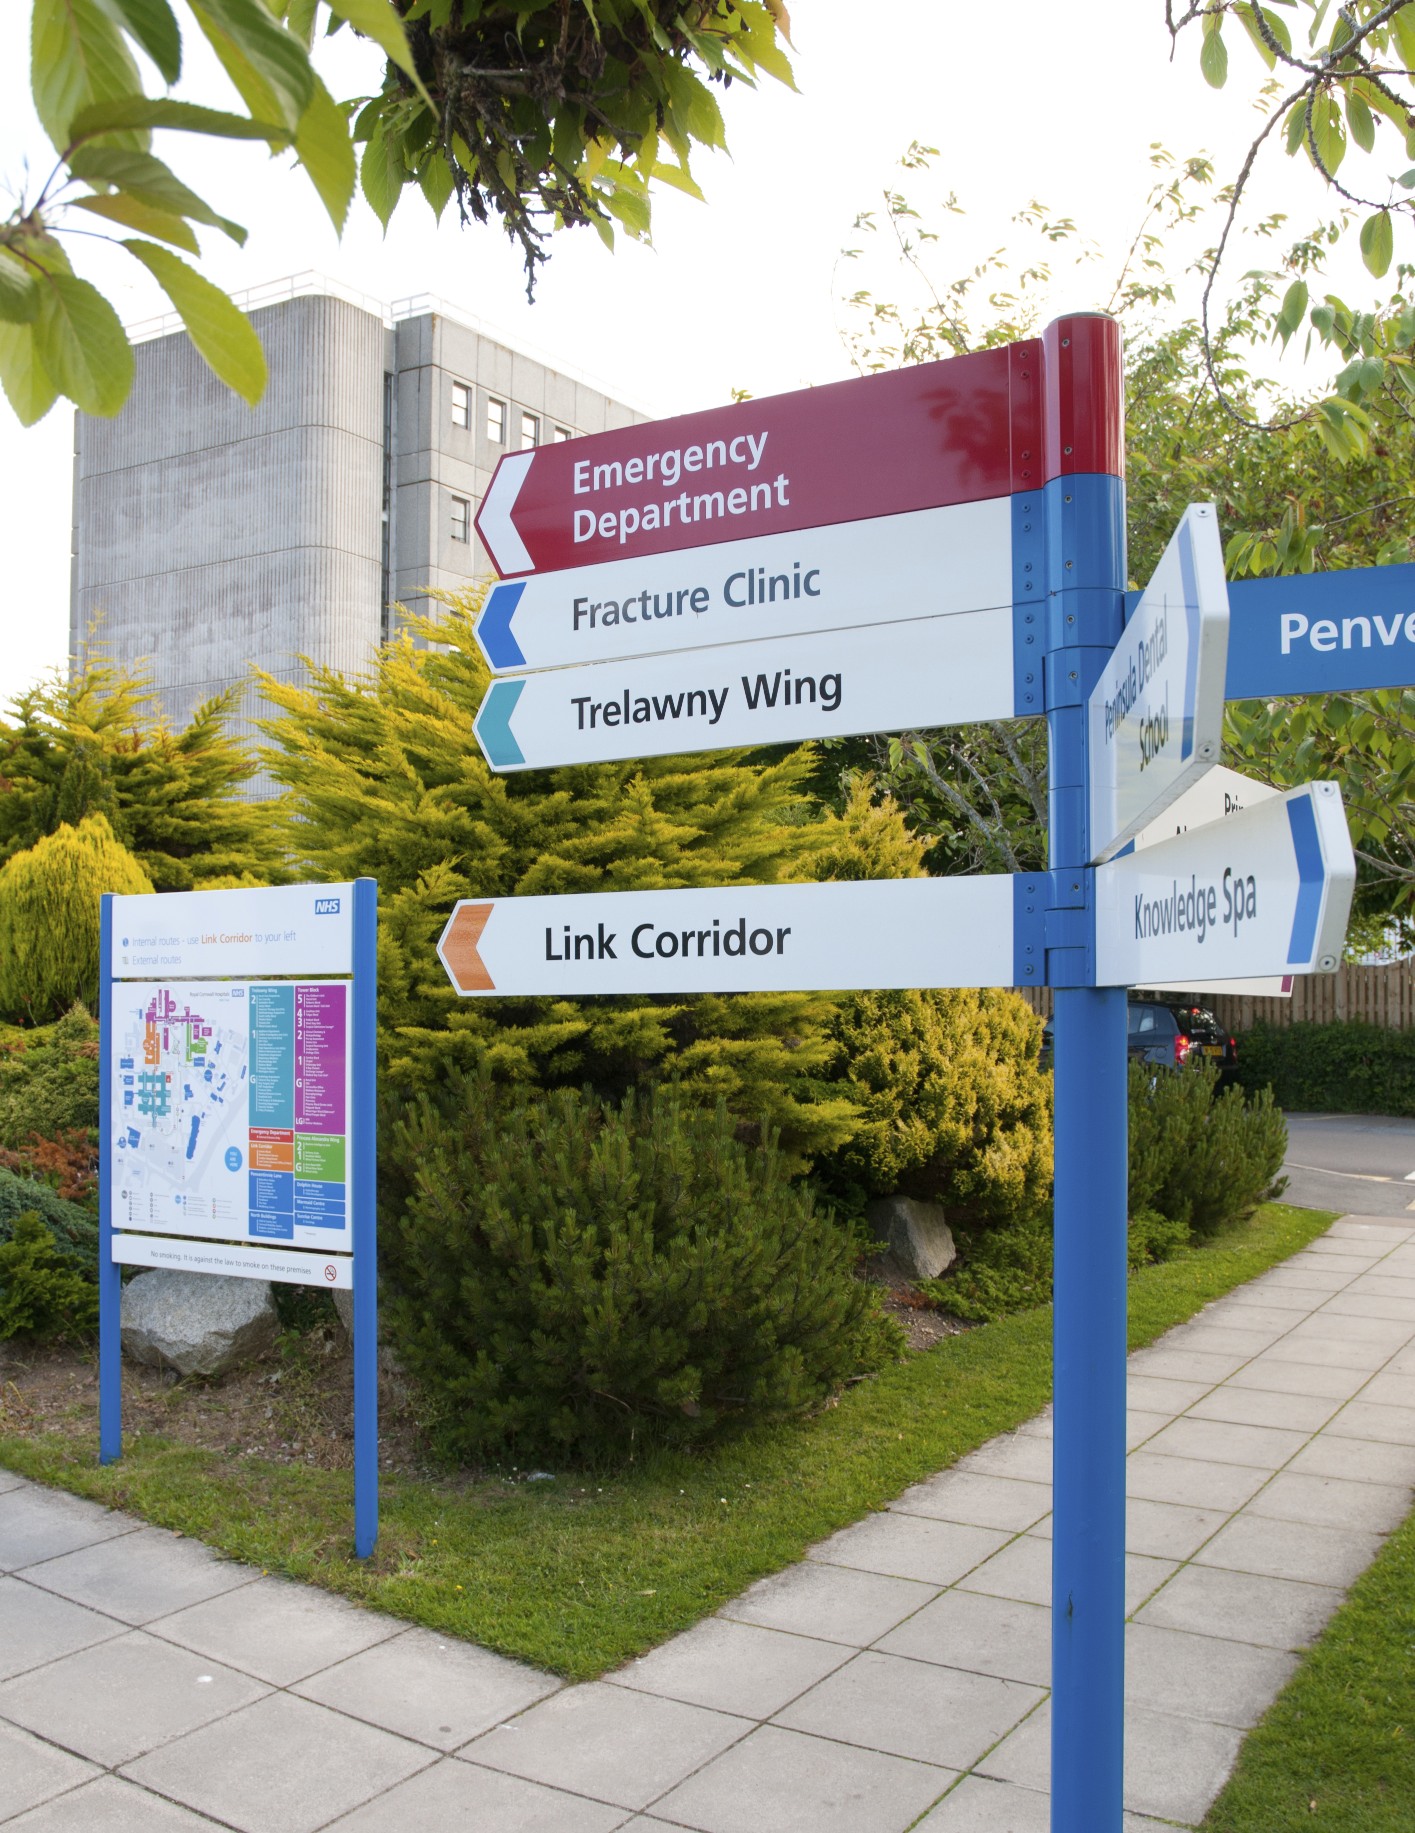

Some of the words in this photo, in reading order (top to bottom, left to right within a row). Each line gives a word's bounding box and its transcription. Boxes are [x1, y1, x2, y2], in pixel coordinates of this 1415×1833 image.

[573, 431, 769, 494] Emergency
[573, 474, 790, 544] Department
[573, 586, 709, 631] Fracture
[723, 561, 821, 608] Clinic
[1105, 655, 1137, 745] Peninsula
[1138, 592, 1168, 695] Dental
[571, 686, 730, 730] Trelawny
[741, 669, 842, 712] Wing
[1140, 679, 1169, 772] School
[316, 900, 339, 912] NHS
[1135, 874, 1217, 944] Knowledge
[1223, 866, 1256, 938] Spa
[132, 936, 156, 947] Internal
[159, 937, 180, 946] routes
[187, 936, 199, 944] use
[201, 933, 217, 944] Link
[220, 932, 252, 944] Corridor
[255, 932, 263, 942] to
[265, 932, 281, 944] your
[284, 930, 296, 941] left
[546, 923, 618, 961] Link
[631, 918, 792, 958] Corridor
[132, 954, 158, 966] External
[160, 956, 182, 965] routes
[251, 995, 256, 1004] 2
[298, 994, 302, 1003] 5
[297, 1009, 302, 1017] 4
[298, 1018, 302, 1027] 3
[252, 1030, 256, 1039] 1
[297, 1030, 302, 1039] 2
[298, 1056, 302, 1065] 1
[250, 1075, 256, 1084] G
[296, 1078, 302, 1088] G
[297, 1142, 302, 1150] 2
[298, 1151, 302, 1160] 1
[296, 1163, 302, 1172] G
[160, 1251, 182, 1261] smoking.
[243, 1261, 260, 1269] smoke
[270, 1264, 285, 1272] these
[287, 1266, 312, 1275] premises
